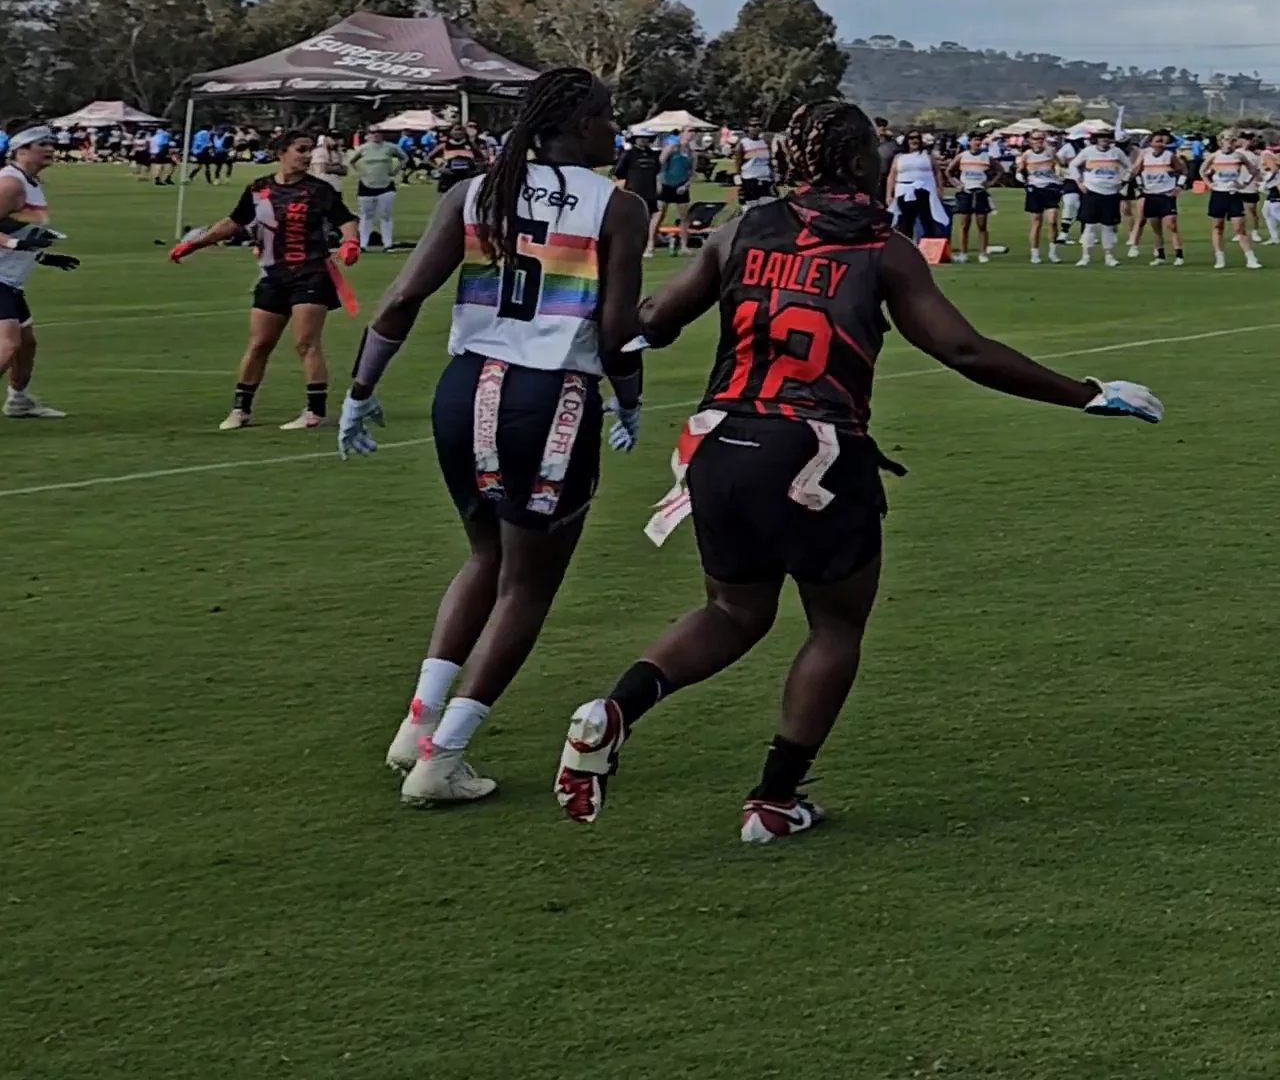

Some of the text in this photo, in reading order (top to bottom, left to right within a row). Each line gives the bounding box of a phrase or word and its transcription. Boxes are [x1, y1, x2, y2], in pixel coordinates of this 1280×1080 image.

[333, 56, 441, 79] SPORTS
[521, 186, 580, 212] OPER
[496, 218, 550, 322] 6
[741, 248, 848, 299] BAILEY
[713, 300, 833, 400] 12
